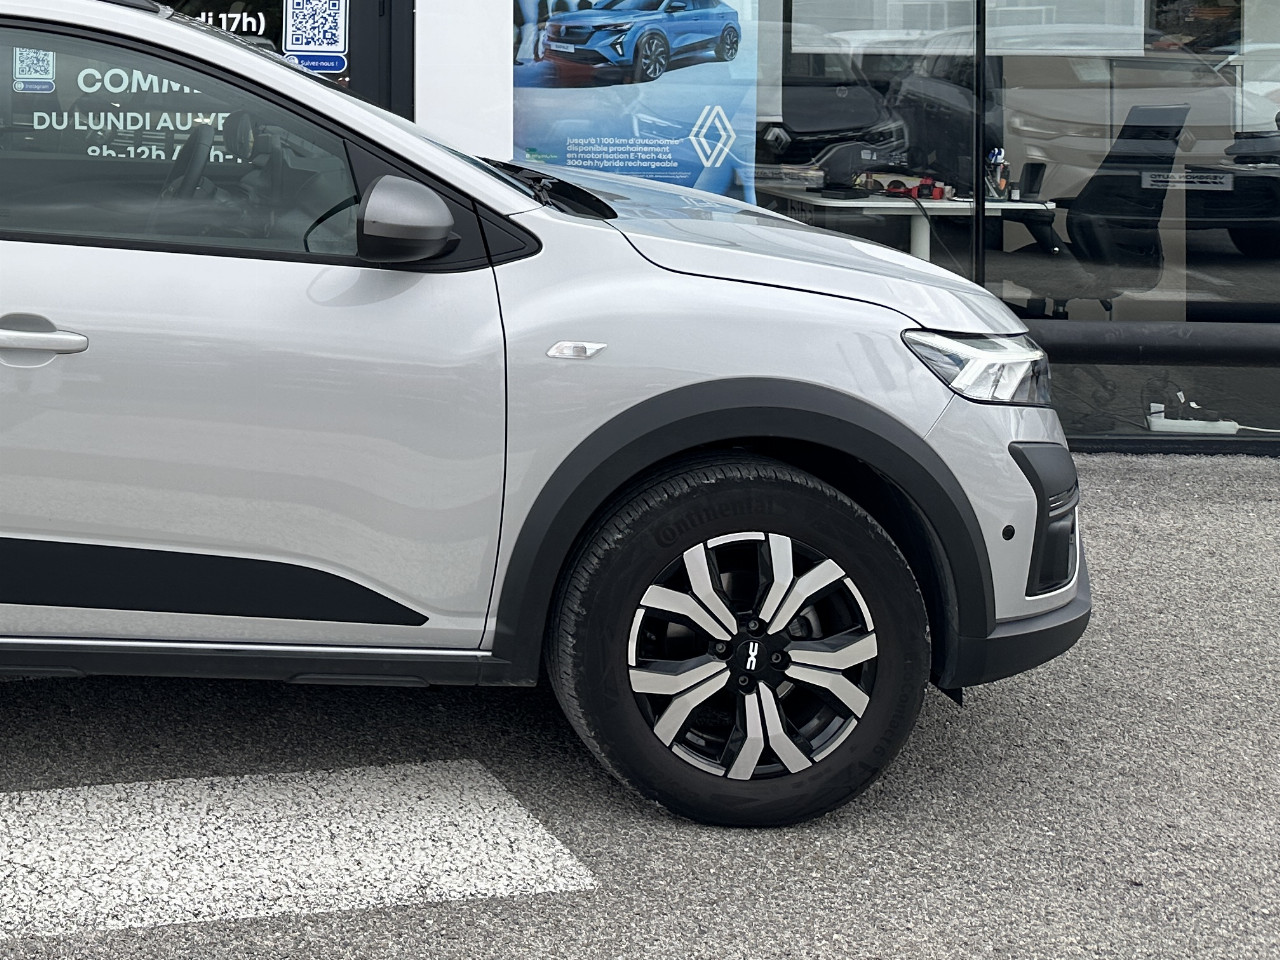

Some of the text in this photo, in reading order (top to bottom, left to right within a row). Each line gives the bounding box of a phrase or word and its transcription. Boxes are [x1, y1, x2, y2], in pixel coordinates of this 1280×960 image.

[33, 112, 68, 130] DU
[74, 112, 151, 131] LUNDI
[156, 112, 193, 131] AU
[566, 137, 596, 145] jusqu'à
[566, 145, 670, 153] disponible prochainement
[594, 159, 624, 168] hybride
[625, 159, 678, 168] rechargeable
[654, 498, 775, 549] Continental
